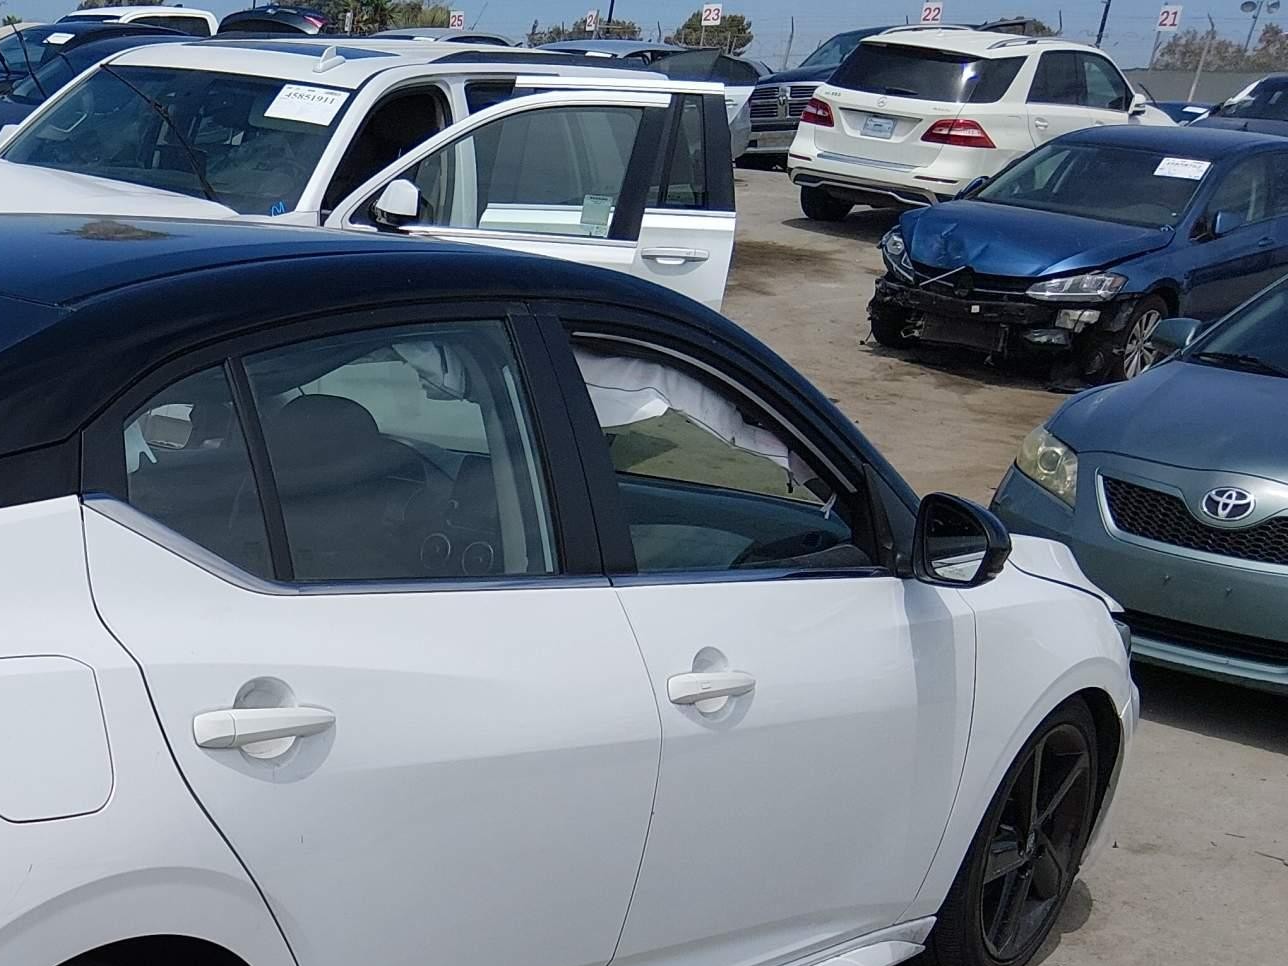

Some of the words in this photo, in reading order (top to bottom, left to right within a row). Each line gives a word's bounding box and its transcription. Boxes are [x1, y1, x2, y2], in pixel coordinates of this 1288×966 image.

[450, 14, 463, 27] 25
[703, 8, 720, 21] 23
[922, 7, 941, 21] 22
[1158, 10, 1178, 27] 21
